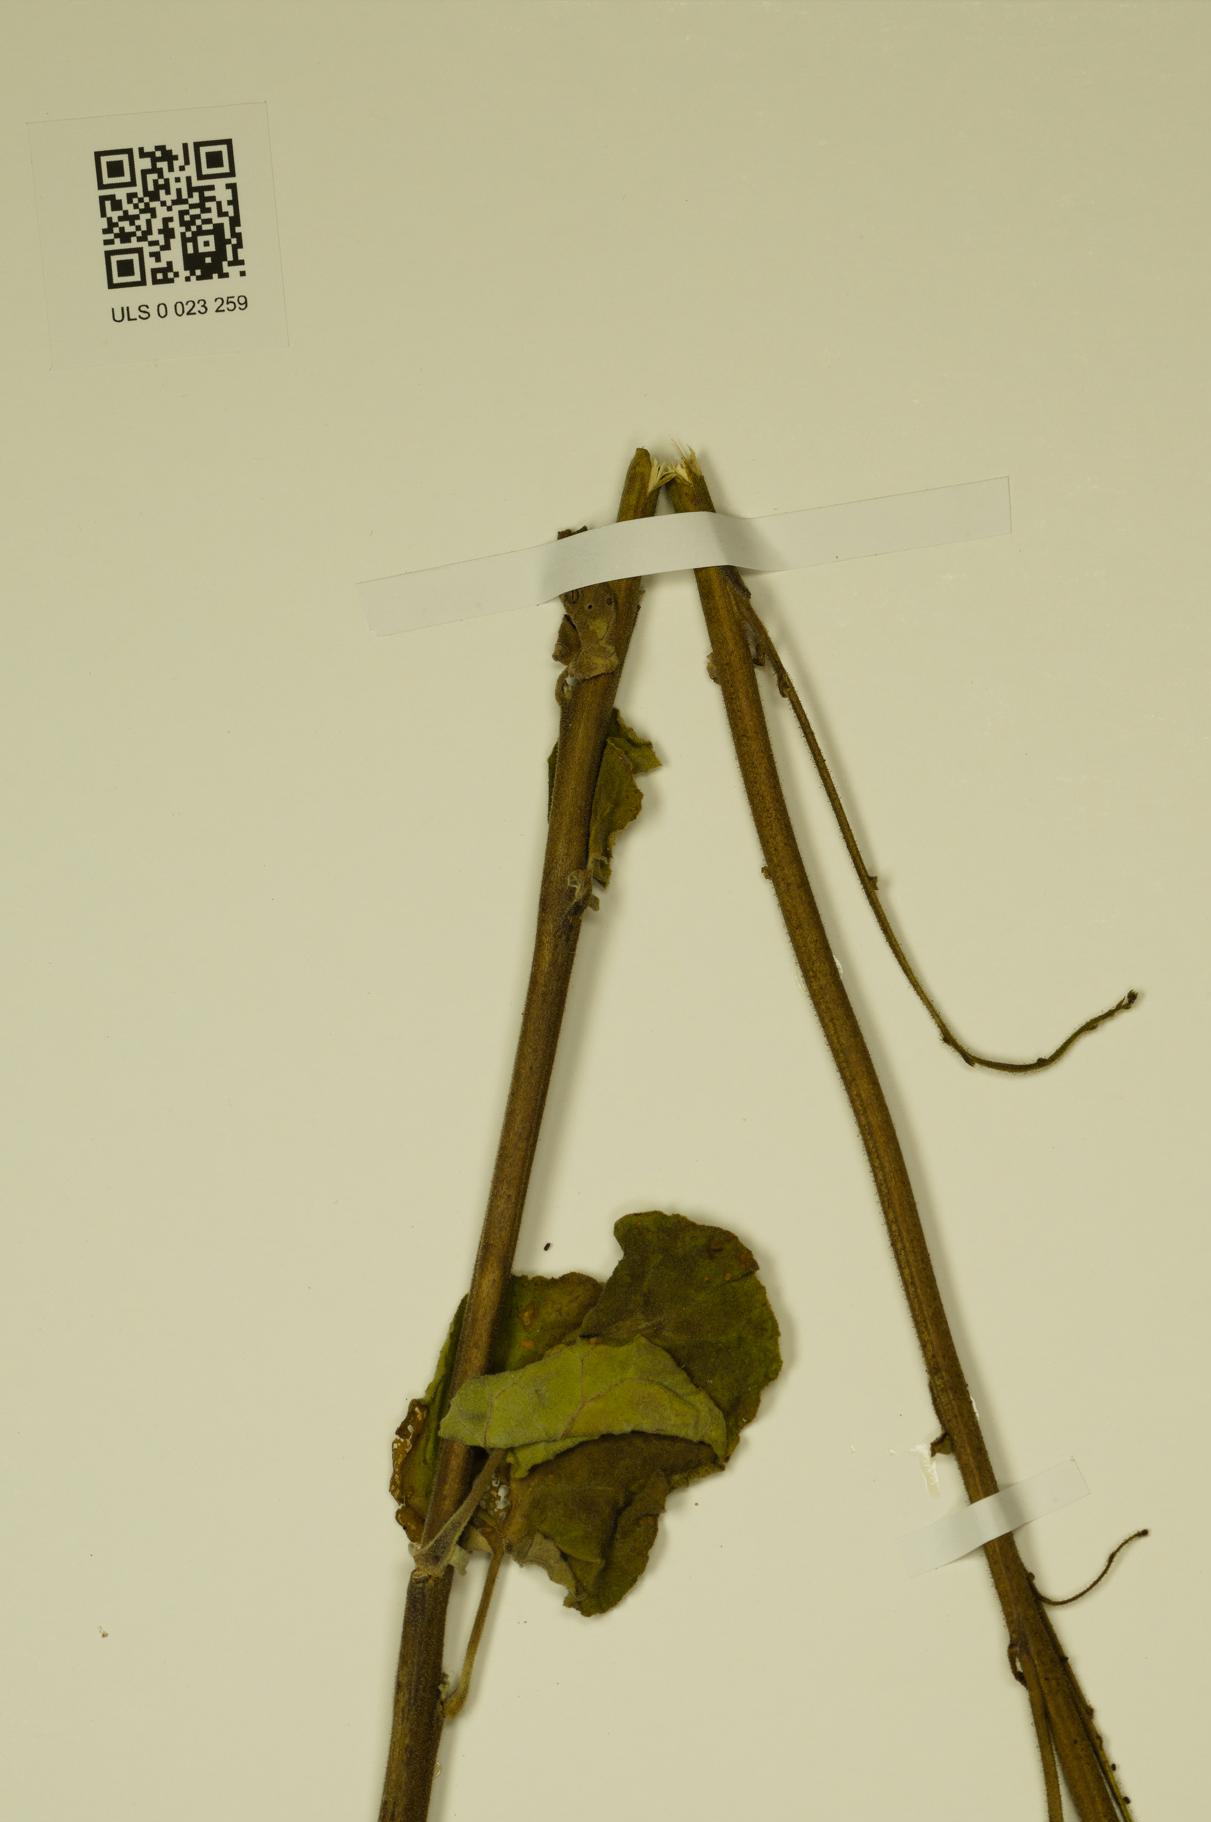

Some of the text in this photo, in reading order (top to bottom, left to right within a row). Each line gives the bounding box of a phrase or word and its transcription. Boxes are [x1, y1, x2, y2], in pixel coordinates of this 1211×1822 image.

[112, 294, 249, 324] ULS 0 023 259
